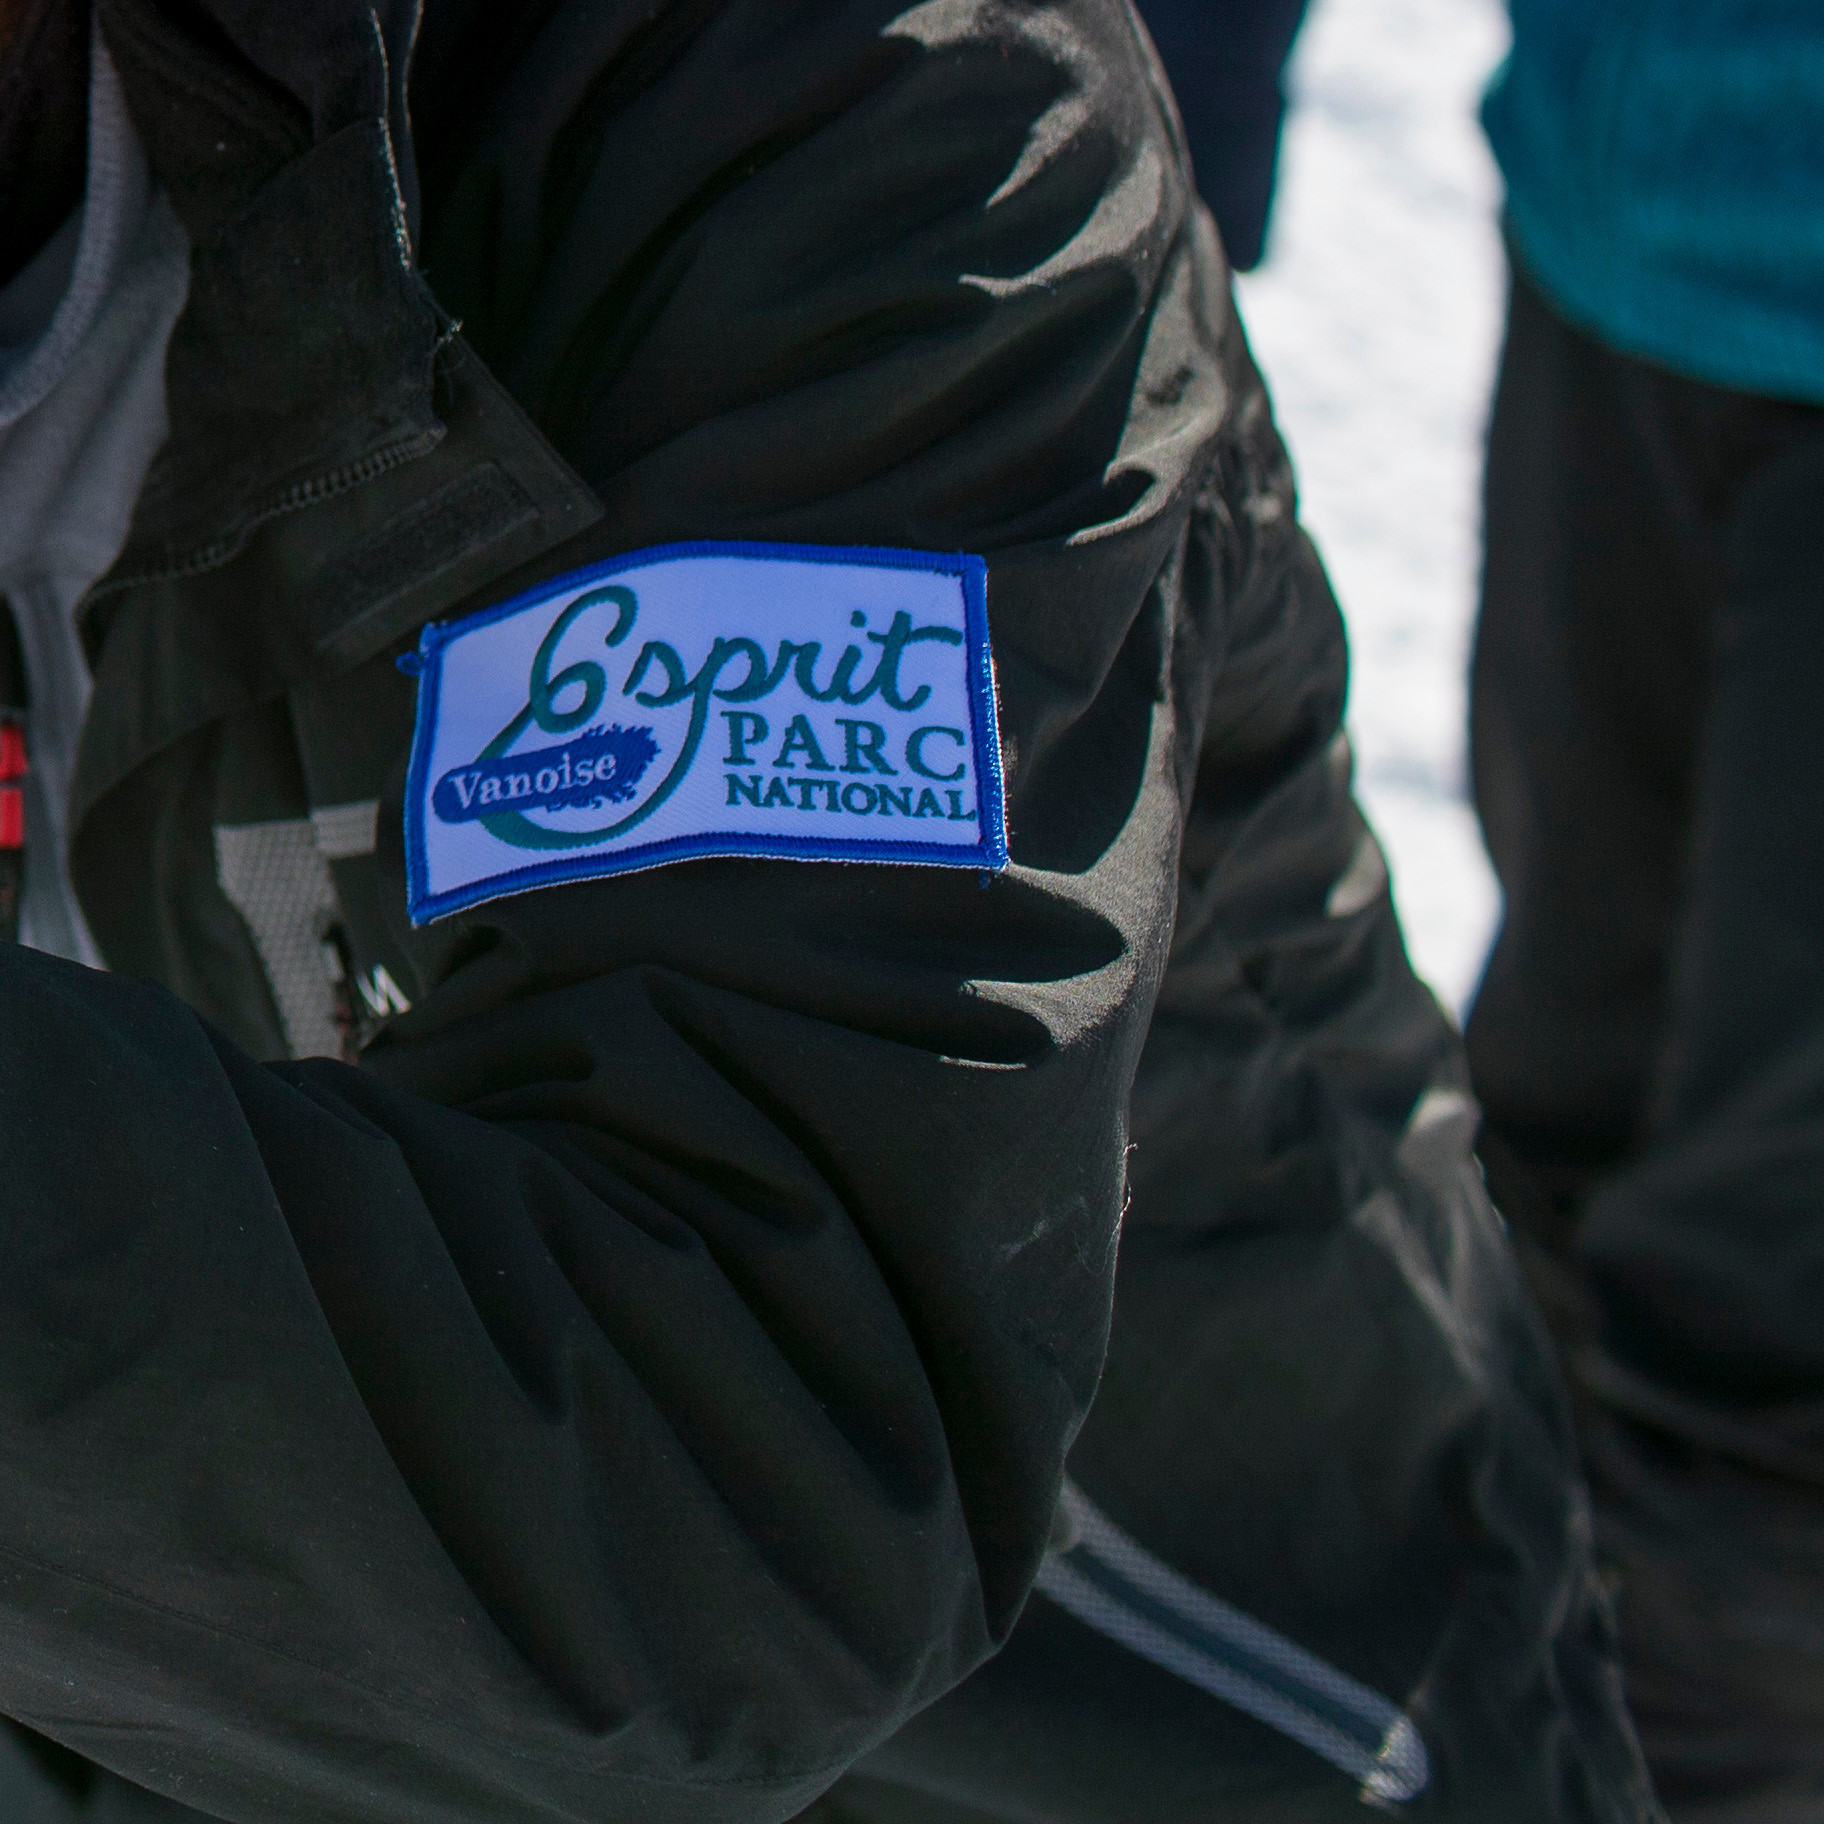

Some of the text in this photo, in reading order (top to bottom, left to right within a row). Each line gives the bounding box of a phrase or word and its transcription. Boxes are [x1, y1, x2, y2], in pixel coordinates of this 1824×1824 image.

[522, 584, 964, 776] Esprit
[720, 710, 966, 782] PARC
[450, 751, 618, 810] Vanoise
[722, 773, 977, 821] NATIONAL
